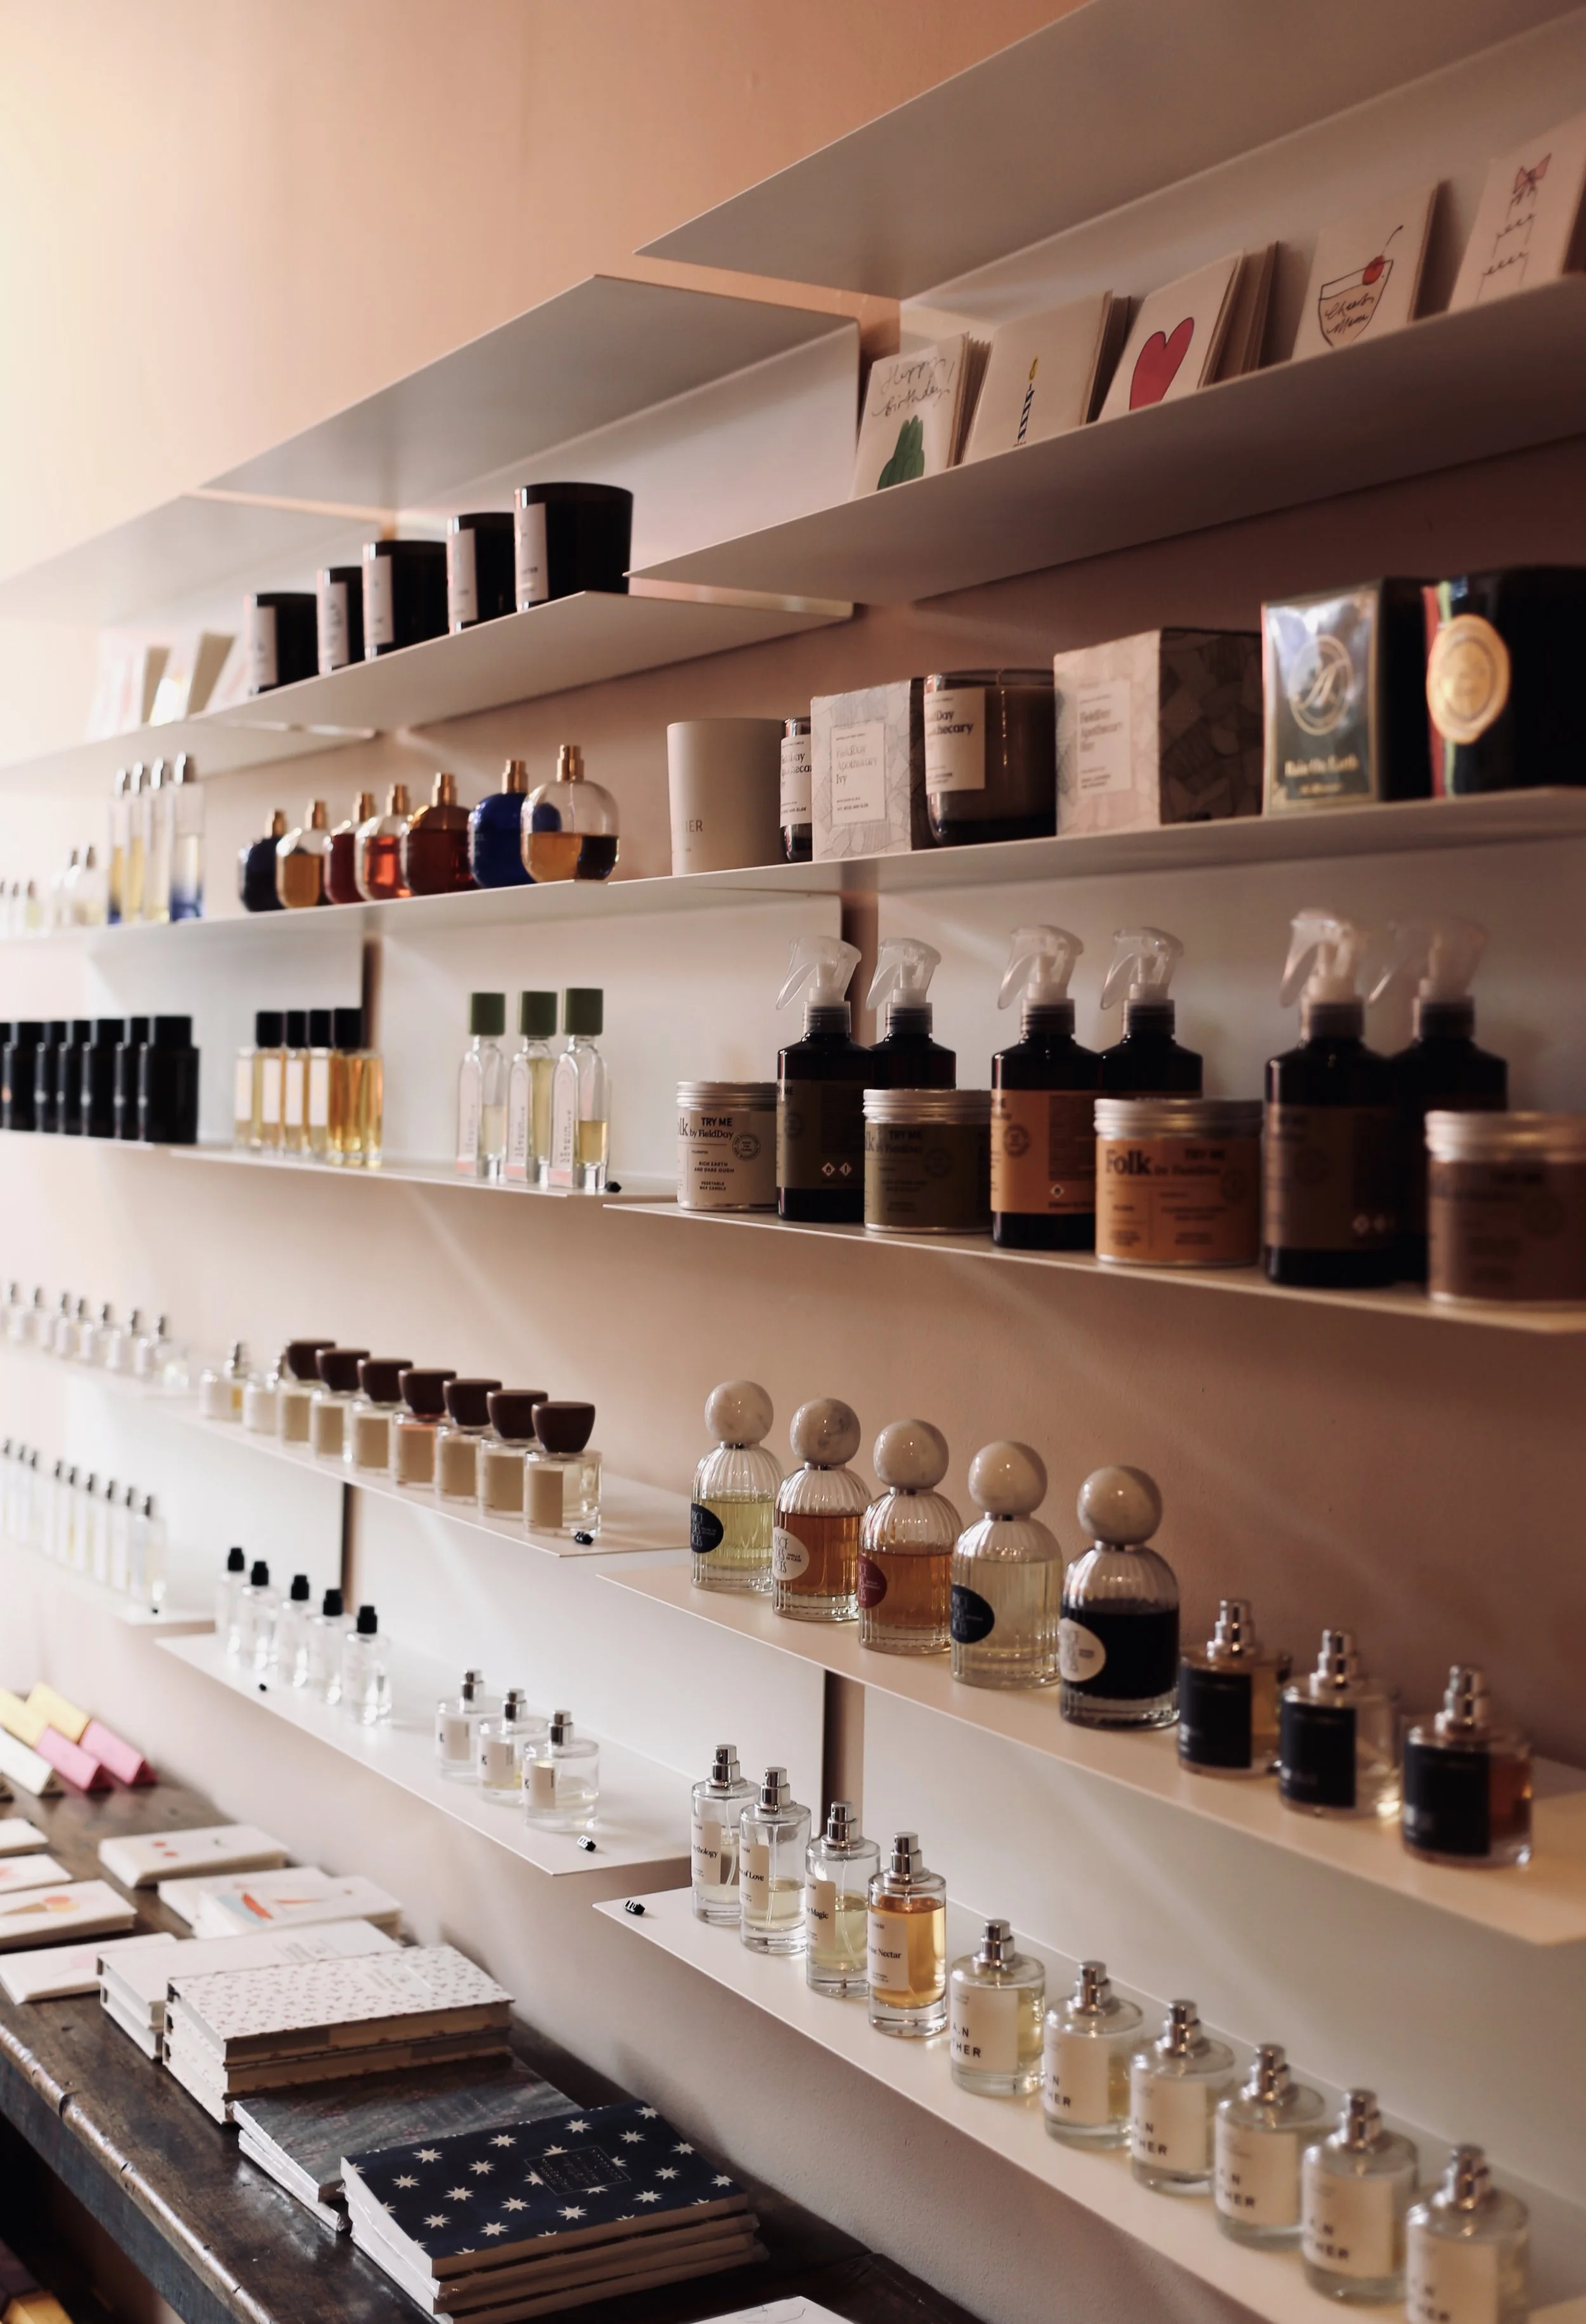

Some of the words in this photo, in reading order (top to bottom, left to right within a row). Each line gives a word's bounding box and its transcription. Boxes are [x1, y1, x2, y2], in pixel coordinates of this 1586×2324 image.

[836, 773, 848, 787] Ivy
[701, 1117, 718, 1127] TRY
[718, 1117, 733, 1127] ME
[689, 1129, 697, 1138] by
[698, 1129, 735, 1140] FieldDay
[1106, 1148, 1153, 1176] Folk
[749, 1872, 764, 1881] Love
[810, 1908, 829, 1920] Magic
[878, 1948, 902, 1959] Nectar
